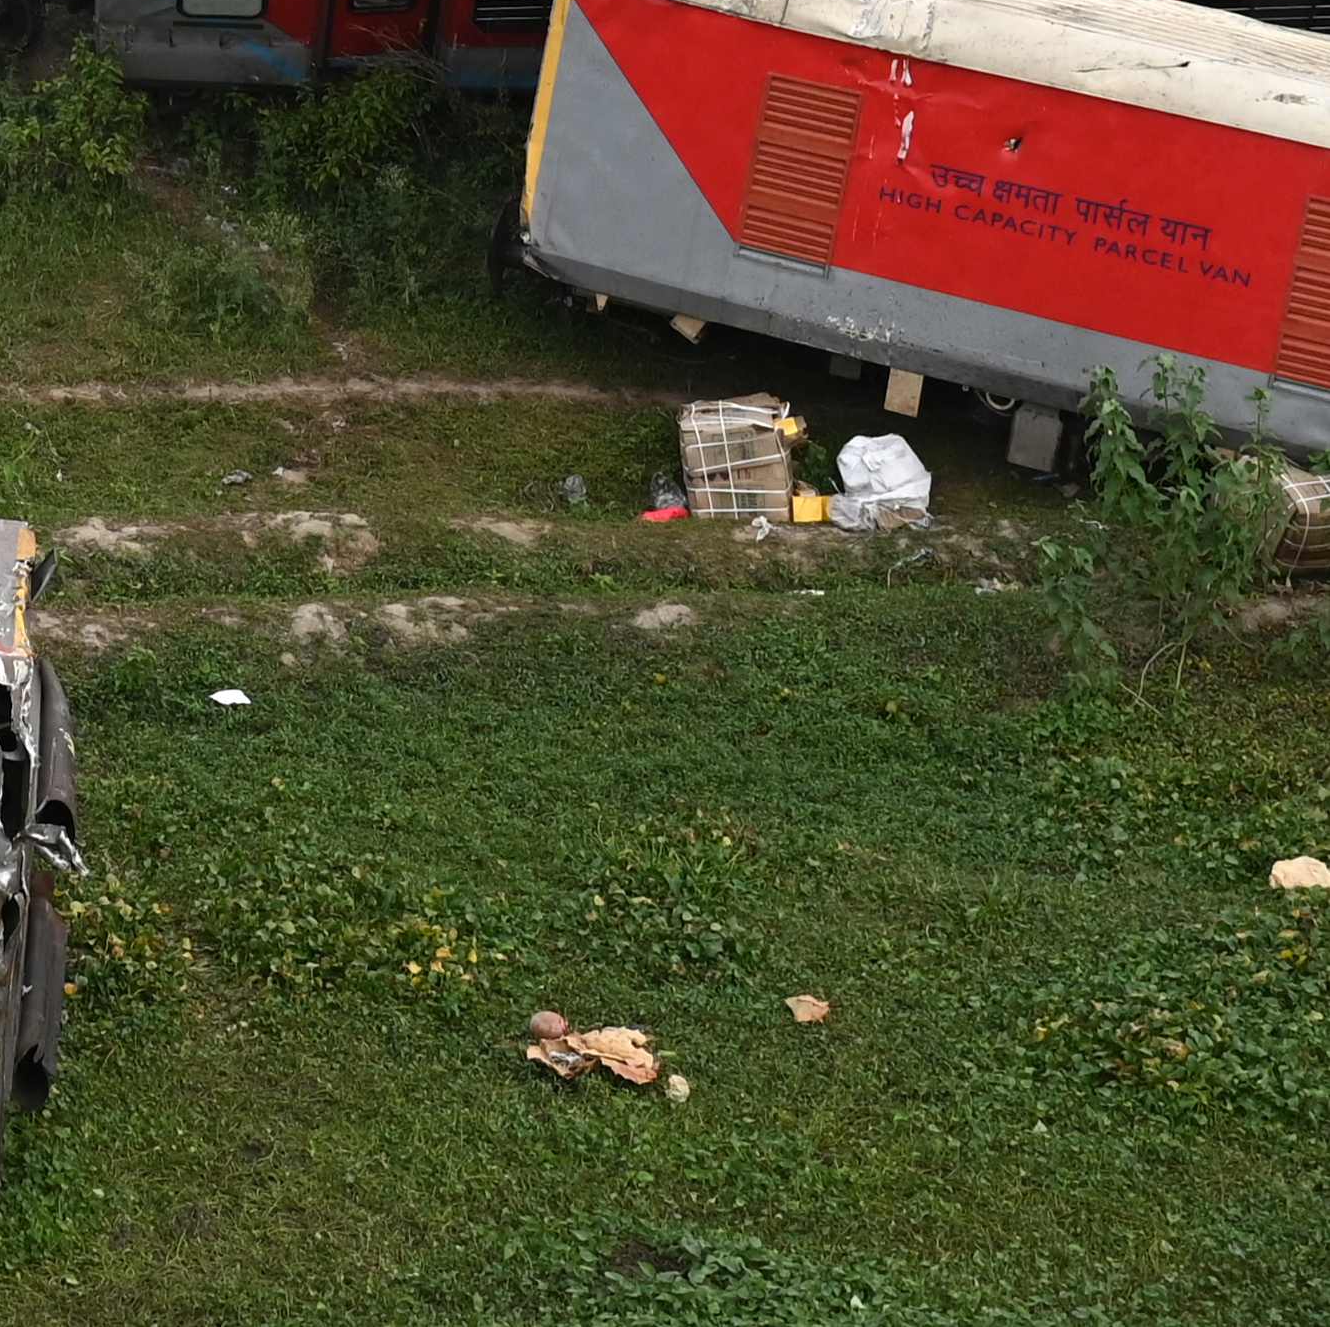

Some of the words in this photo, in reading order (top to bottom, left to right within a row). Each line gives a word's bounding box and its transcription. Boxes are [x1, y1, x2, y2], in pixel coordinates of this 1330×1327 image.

[879, 186, 941, 214] HIGH
[954, 204, 1077, 246] CAPACITY
[1094, 236, 1188, 273] PARCEL
[1200, 260, 1252, 288] VAN
[929, 163, 988, 198] उच्च
[992, 178, 1063, 215] क्षमता
[1075, 197, 1150, 237] पार्सल
[1160, 216, 1213, 251] यान
